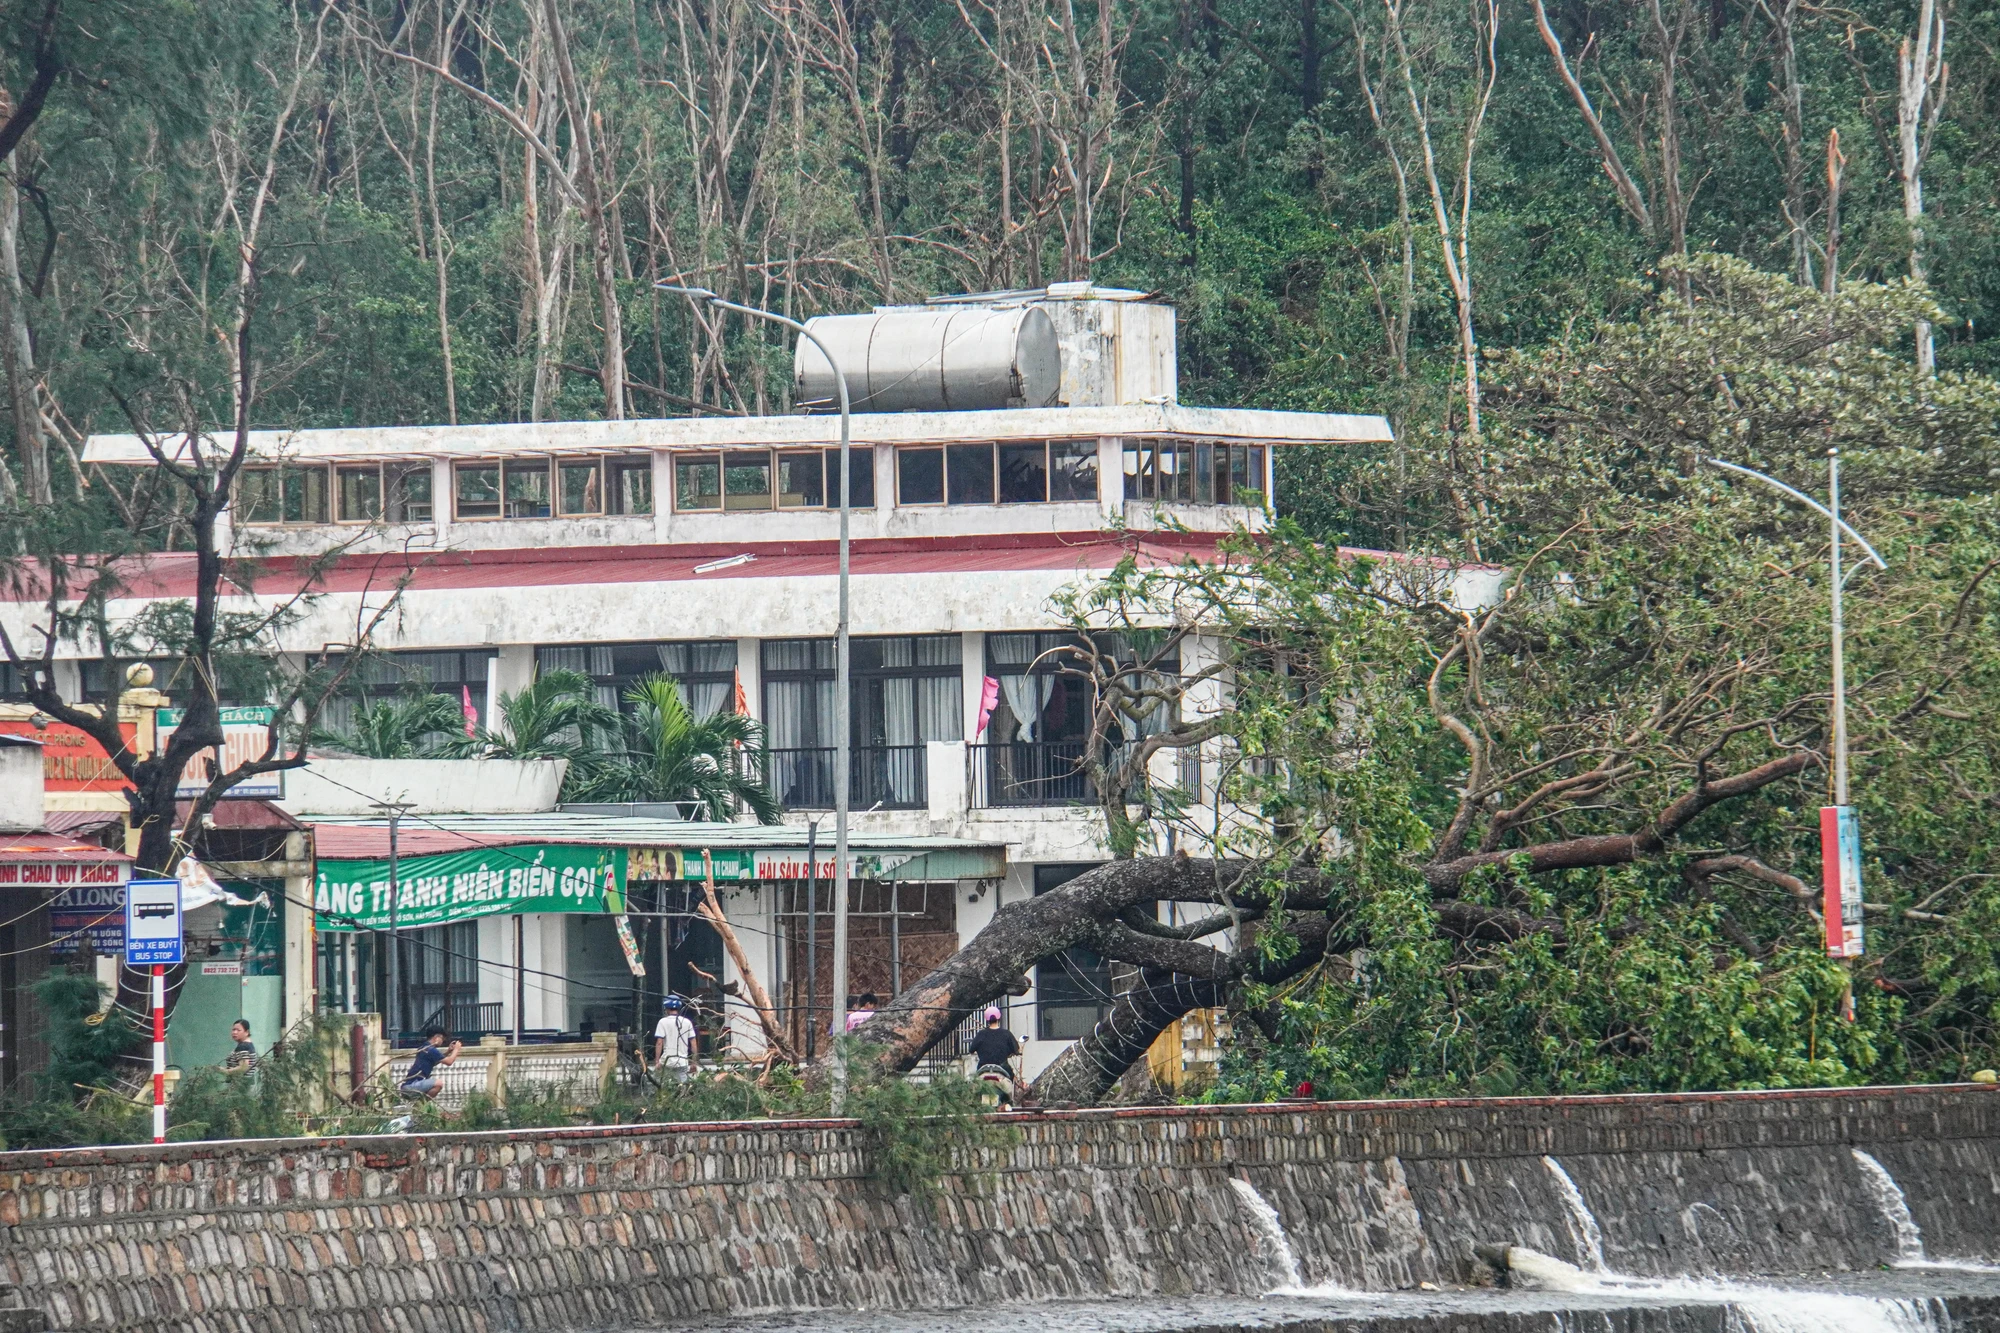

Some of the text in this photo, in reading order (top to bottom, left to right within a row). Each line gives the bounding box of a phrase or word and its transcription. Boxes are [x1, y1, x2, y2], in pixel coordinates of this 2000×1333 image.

[369, 875, 449, 912] THANH
[452, 863, 504, 904] NIÊN
[507, 850, 556, 899] BIỂN
[560, 866, 596, 905] GỌI
[75, 887, 126, 907] LONG
[129, 939, 178, 950] BẾN XE BUÝT
[135, 951, 173, 961] BUS STOP
